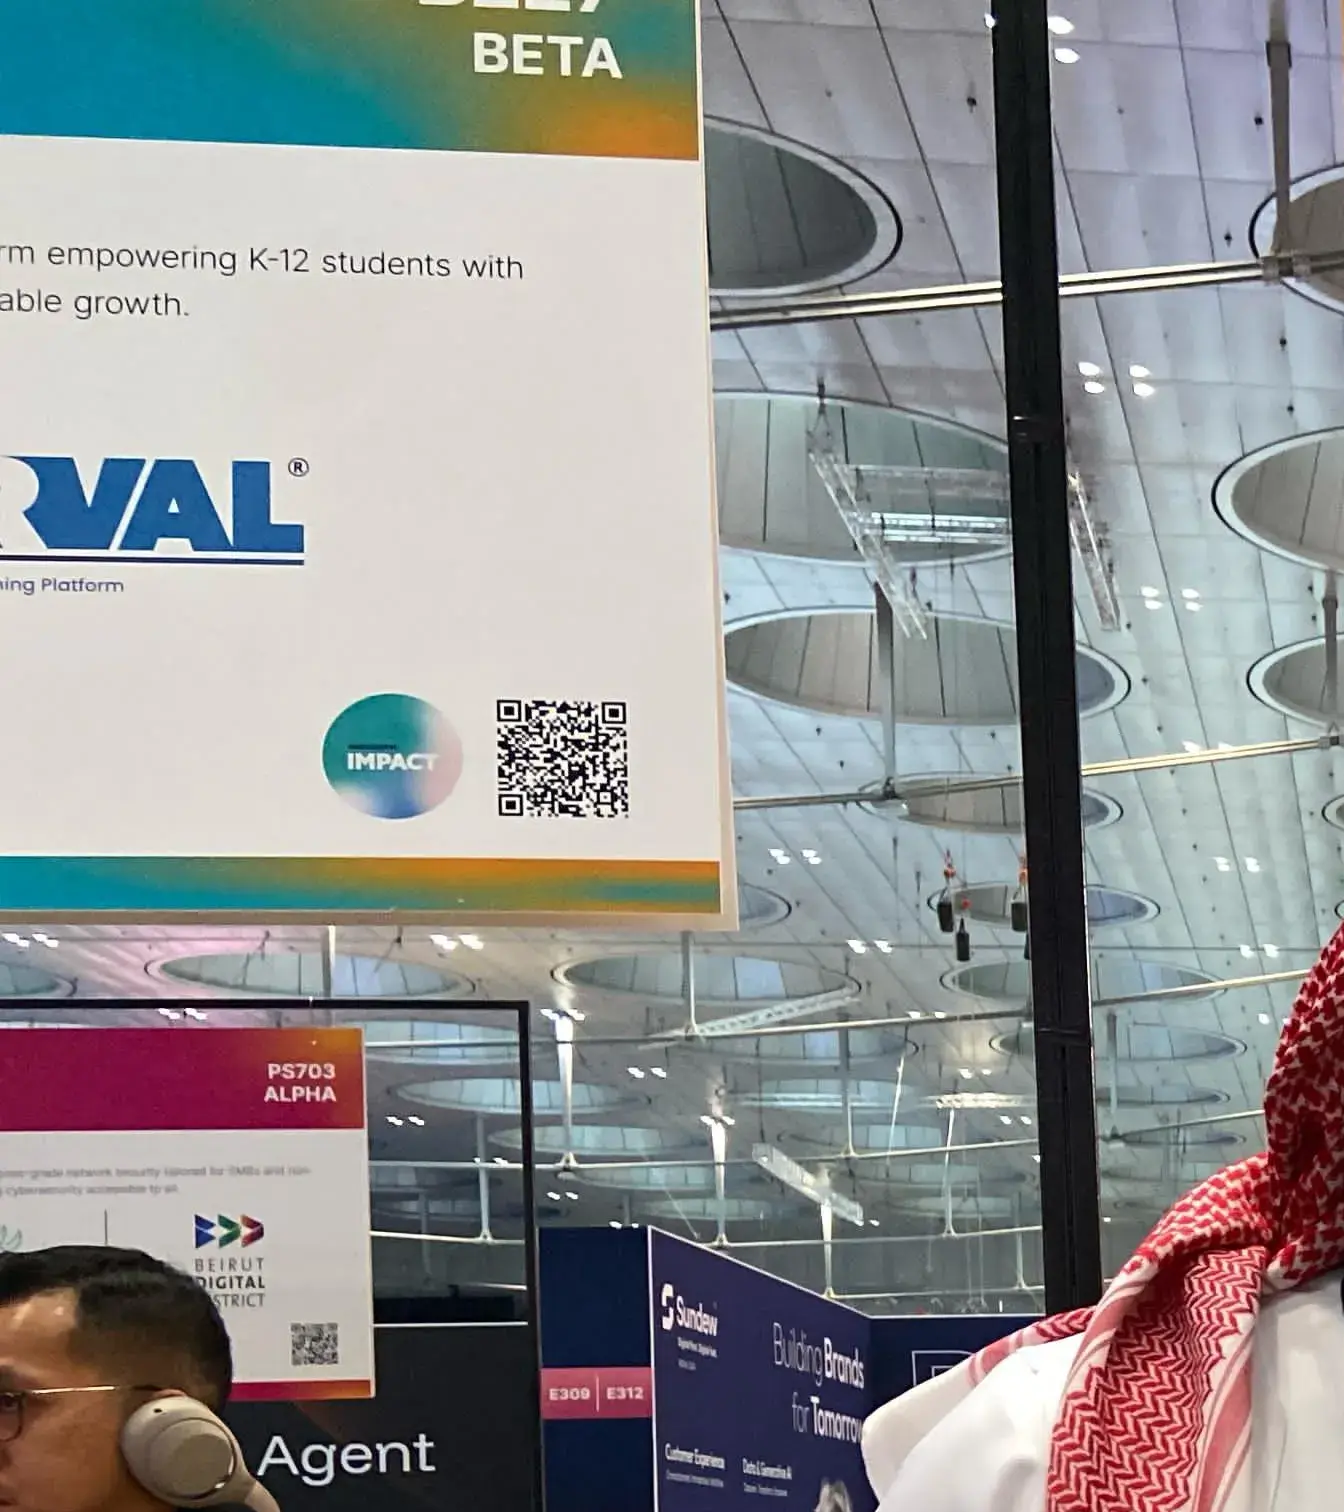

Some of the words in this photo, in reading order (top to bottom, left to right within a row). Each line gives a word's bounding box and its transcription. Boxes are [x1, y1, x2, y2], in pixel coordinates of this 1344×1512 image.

[473, 32, 623, 79] BETA
[47, 245, 237, 276] empowering
[249, 249, 310, 274] K-12
[322, 251, 450, 278] students
[462, 255, 524, 280] with
[74, 292, 189, 319] growth.
[41, 577, 124, 592] Platform
[346, 752, 440, 771] IMPACT
[268, 1063, 337, 1080] PS703
[265, 1086, 337, 1103] ALPHA
[194, 1257, 265, 1272] BEIRUT
[211, 1293, 265, 1308] STRICT
[676, 1295, 718, 1338] Sundew
[772, 1322, 823, 1386] Building
[824, 1336, 865, 1390] Brands
[549, 1388, 590, 1402] E309
[606, 1387, 644, 1400] E312
[792, 1392, 809, 1433] for
[257, 1433, 435, 1487] Agent
